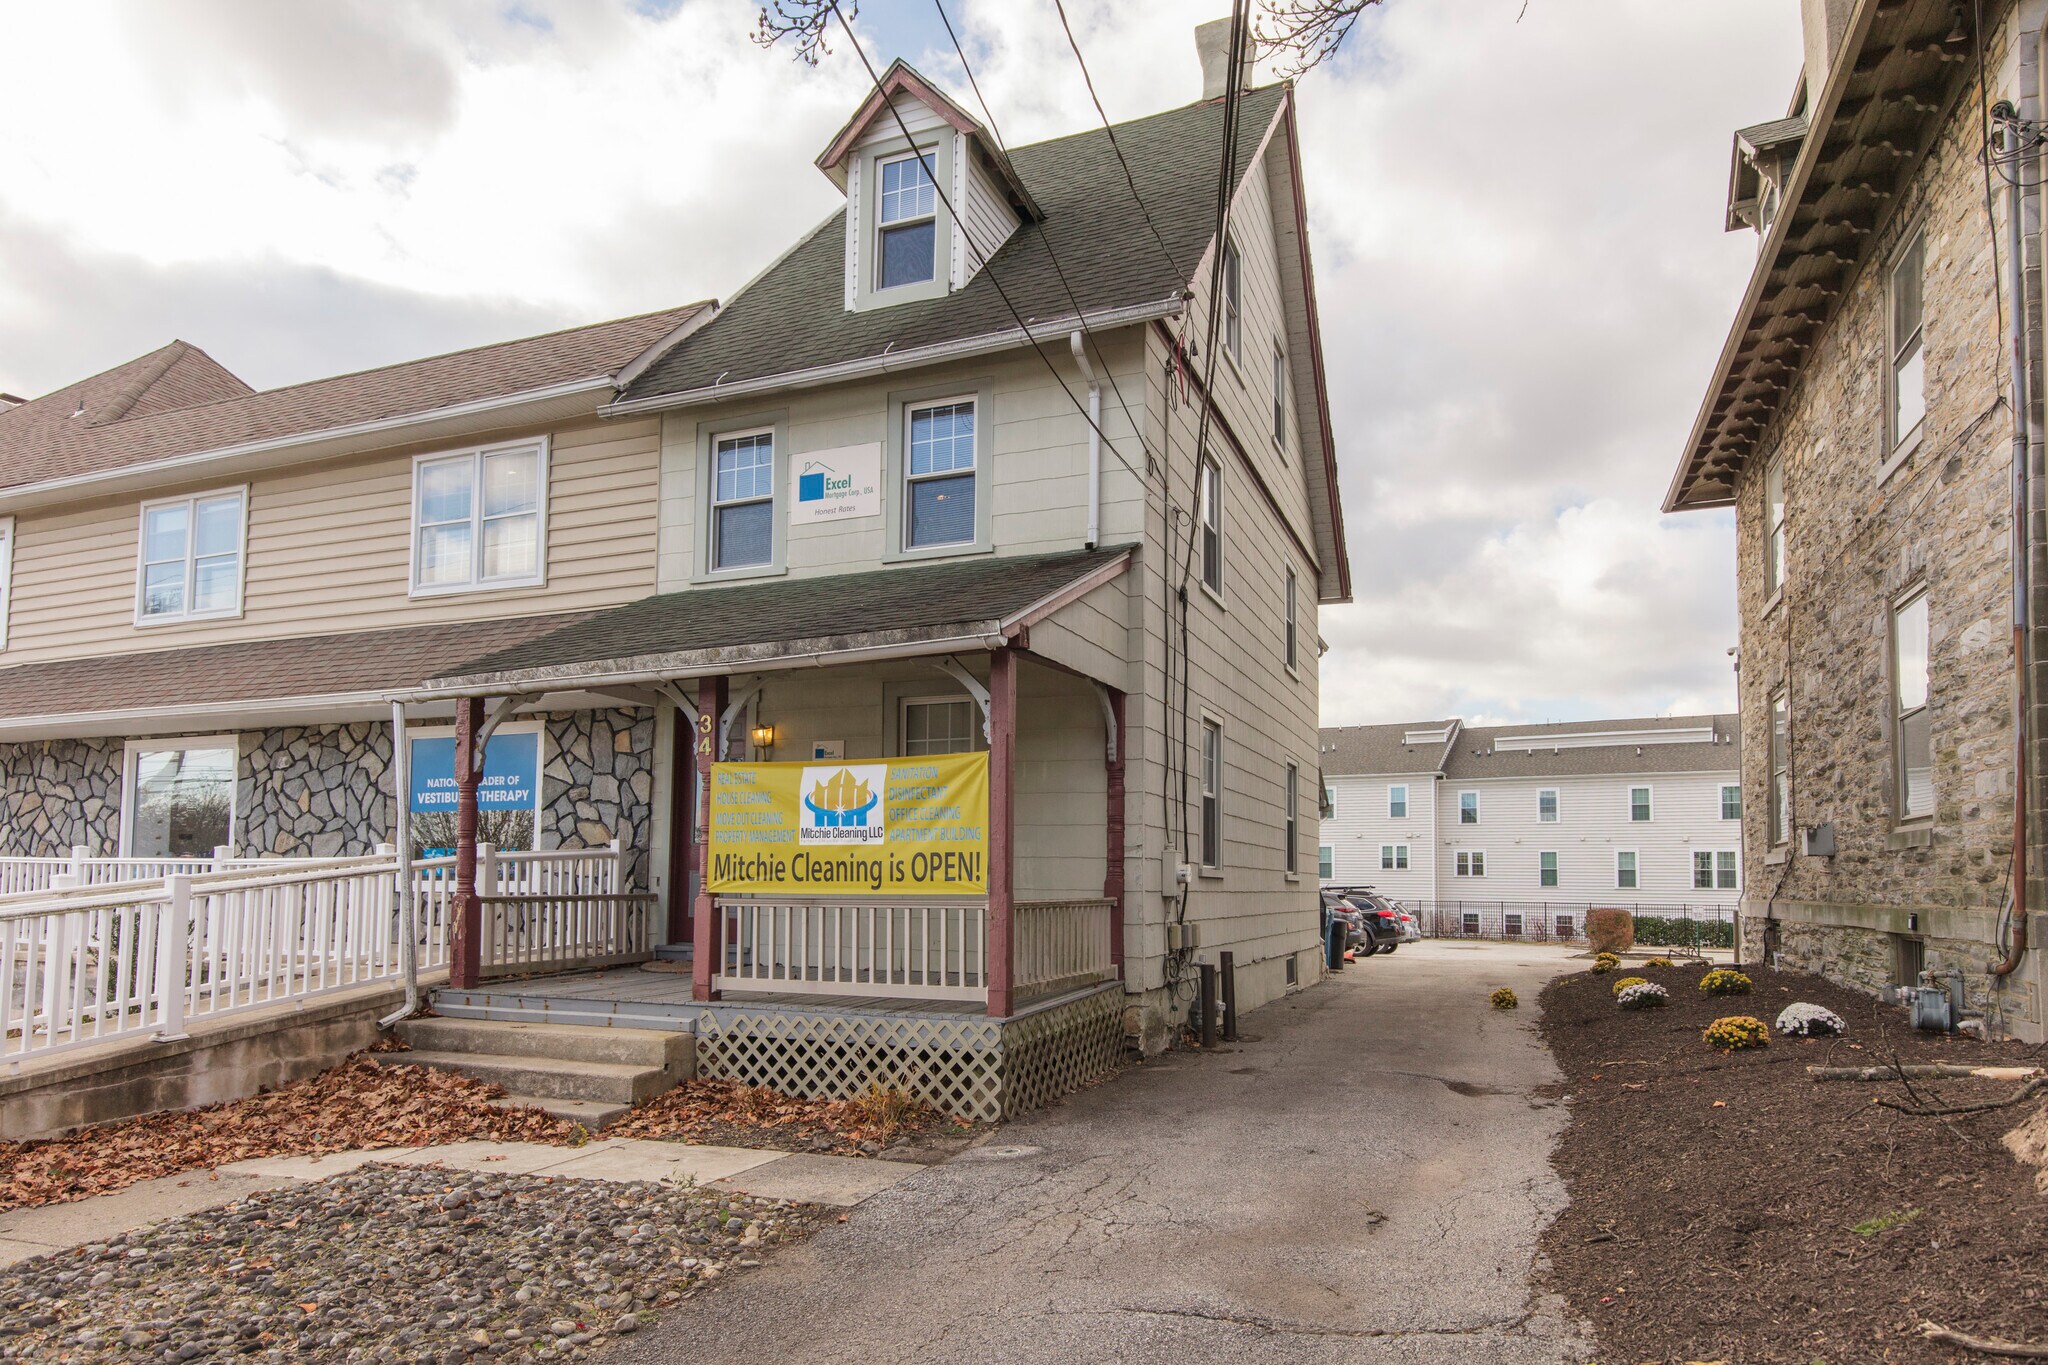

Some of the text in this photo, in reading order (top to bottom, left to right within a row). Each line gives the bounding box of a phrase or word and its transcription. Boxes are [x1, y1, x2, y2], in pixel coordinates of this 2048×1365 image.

[826, 474, 852, 490] Excel
[825, 490, 847, 500] Mortgage
[864, 486, 874, 495] USA
[814, 507, 837, 516] Honest
[717, 772, 756, 785] REAL ESTATE
[890, 766, 938, 780] SANITATION
[427, 776, 520, 788] NATION ADER OF
[418, 790, 529, 804] VESTIBU THERAPY
[716, 791, 772, 804] HOUSE CLEANING
[888, 786, 948, 801] DISINFECTANT
[716, 812, 783, 825] MOVE OUT CLEANING
[889, 806, 961, 821] OFFICE CLEANING
[715, 830, 747, 843] PROPERTY
[749, 830, 796, 843] MANAGEMENT
[801, 827, 831, 839] Mitchie
[832, 826, 868, 842] Cleaning
[869, 826, 883, 838] LLC
[889, 826, 981, 842] APARTMENT BUILDING
[714, 851, 981, 890] Mitchie Cleaning is OPEN!
